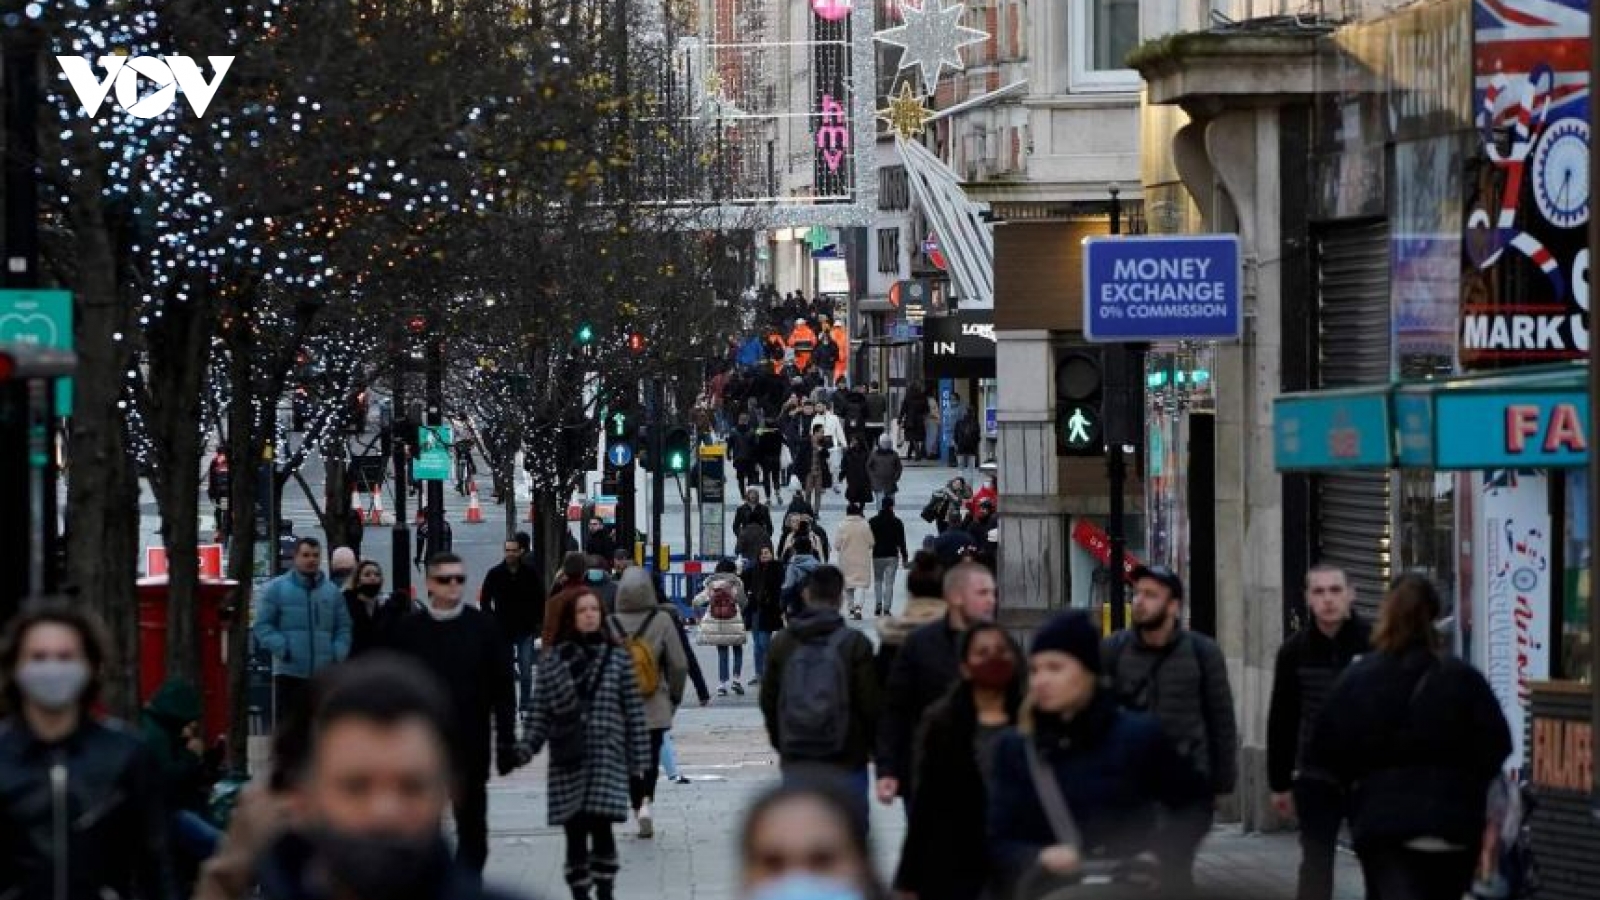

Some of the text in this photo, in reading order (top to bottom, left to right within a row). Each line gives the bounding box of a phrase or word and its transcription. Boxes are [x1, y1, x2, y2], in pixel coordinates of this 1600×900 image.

[818, 94, 849, 173] hmv
[1113, 258, 1211, 280] MONEY
[1101, 282, 1225, 302] EXCHANGE
[1100, 304, 1227, 318] 0% COMMISSION
[1464, 314, 1566, 349] MARK
[933, 341, 955, 354] IN
[1505, 404, 1588, 453] FA
